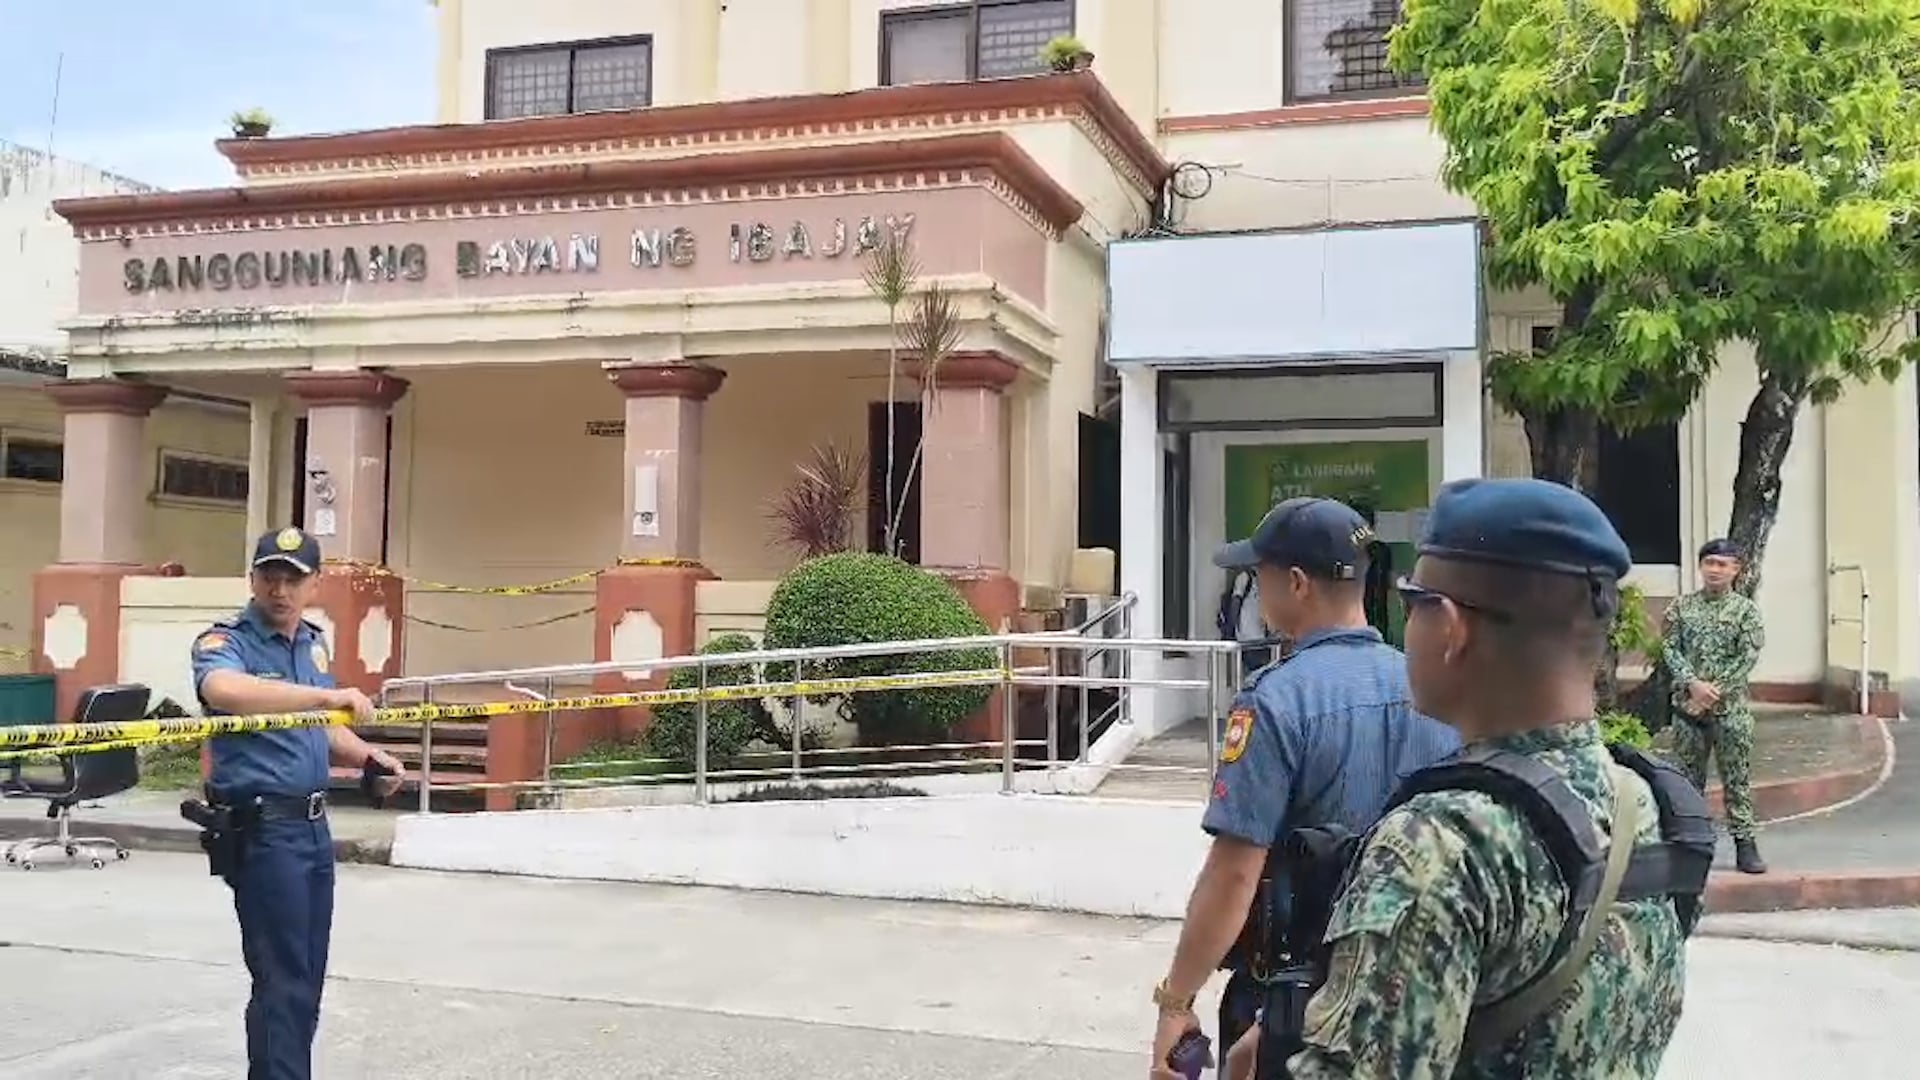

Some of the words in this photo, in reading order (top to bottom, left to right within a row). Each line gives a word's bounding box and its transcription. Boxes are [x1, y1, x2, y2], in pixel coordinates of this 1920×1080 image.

[123, 243, 427, 294] SANGGUNIANG
[457, 234, 599, 279] BAYAN
[629, 226, 696, 268] NG
[729, 212, 916, 263] IBAJAY
